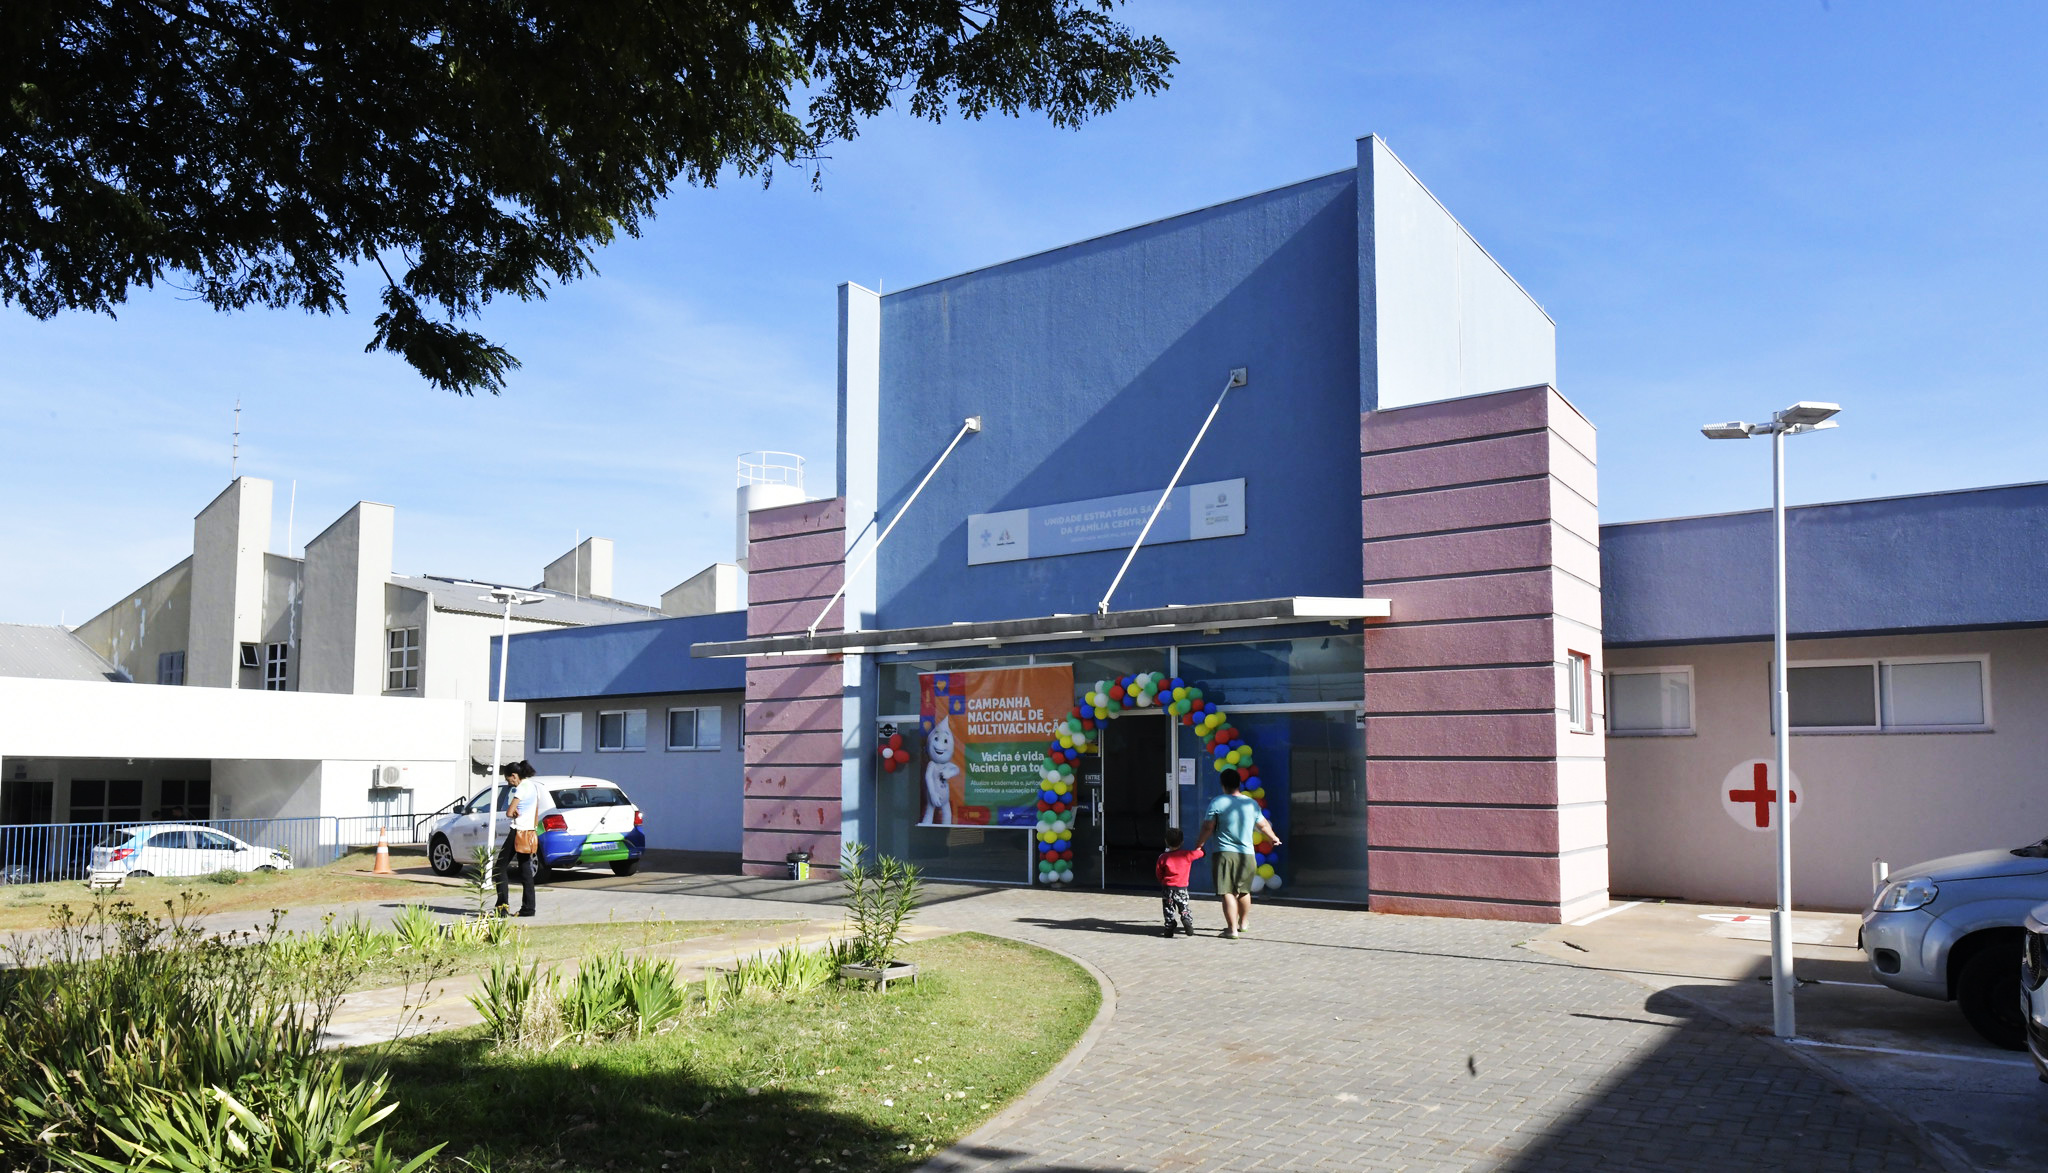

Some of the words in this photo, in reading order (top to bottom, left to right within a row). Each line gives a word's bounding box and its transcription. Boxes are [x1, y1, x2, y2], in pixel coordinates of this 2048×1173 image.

[1044, 514, 1081, 526] UNIDADE
[1084, 506, 1138, 521] ESTRATÉGIA
[1141, 501, 1172, 514] SADE
[1061, 526, 1073, 535] DA
[1075, 521, 1110, 533] FAMÍLIA
[1112, 517, 1149, 529] CENTRA
[968, 696, 1031, 710] CAMPANHA
[968, 710, 1026, 722] NACIONAL
[1028, 708, 1044, 720] DE
[968, 719, 1063, 736] MULTIVACINAÇÃ
[981, 751, 1013, 762] Vacina
[1014, 751, 1021, 762] é
[1022, 751, 1045, 761] vida
[969, 762, 1000, 773] Vacina
[1002, 762, 1008, 772] é
[1010, 764, 1027, 775] pra
[1029, 762, 1042, 772] to
